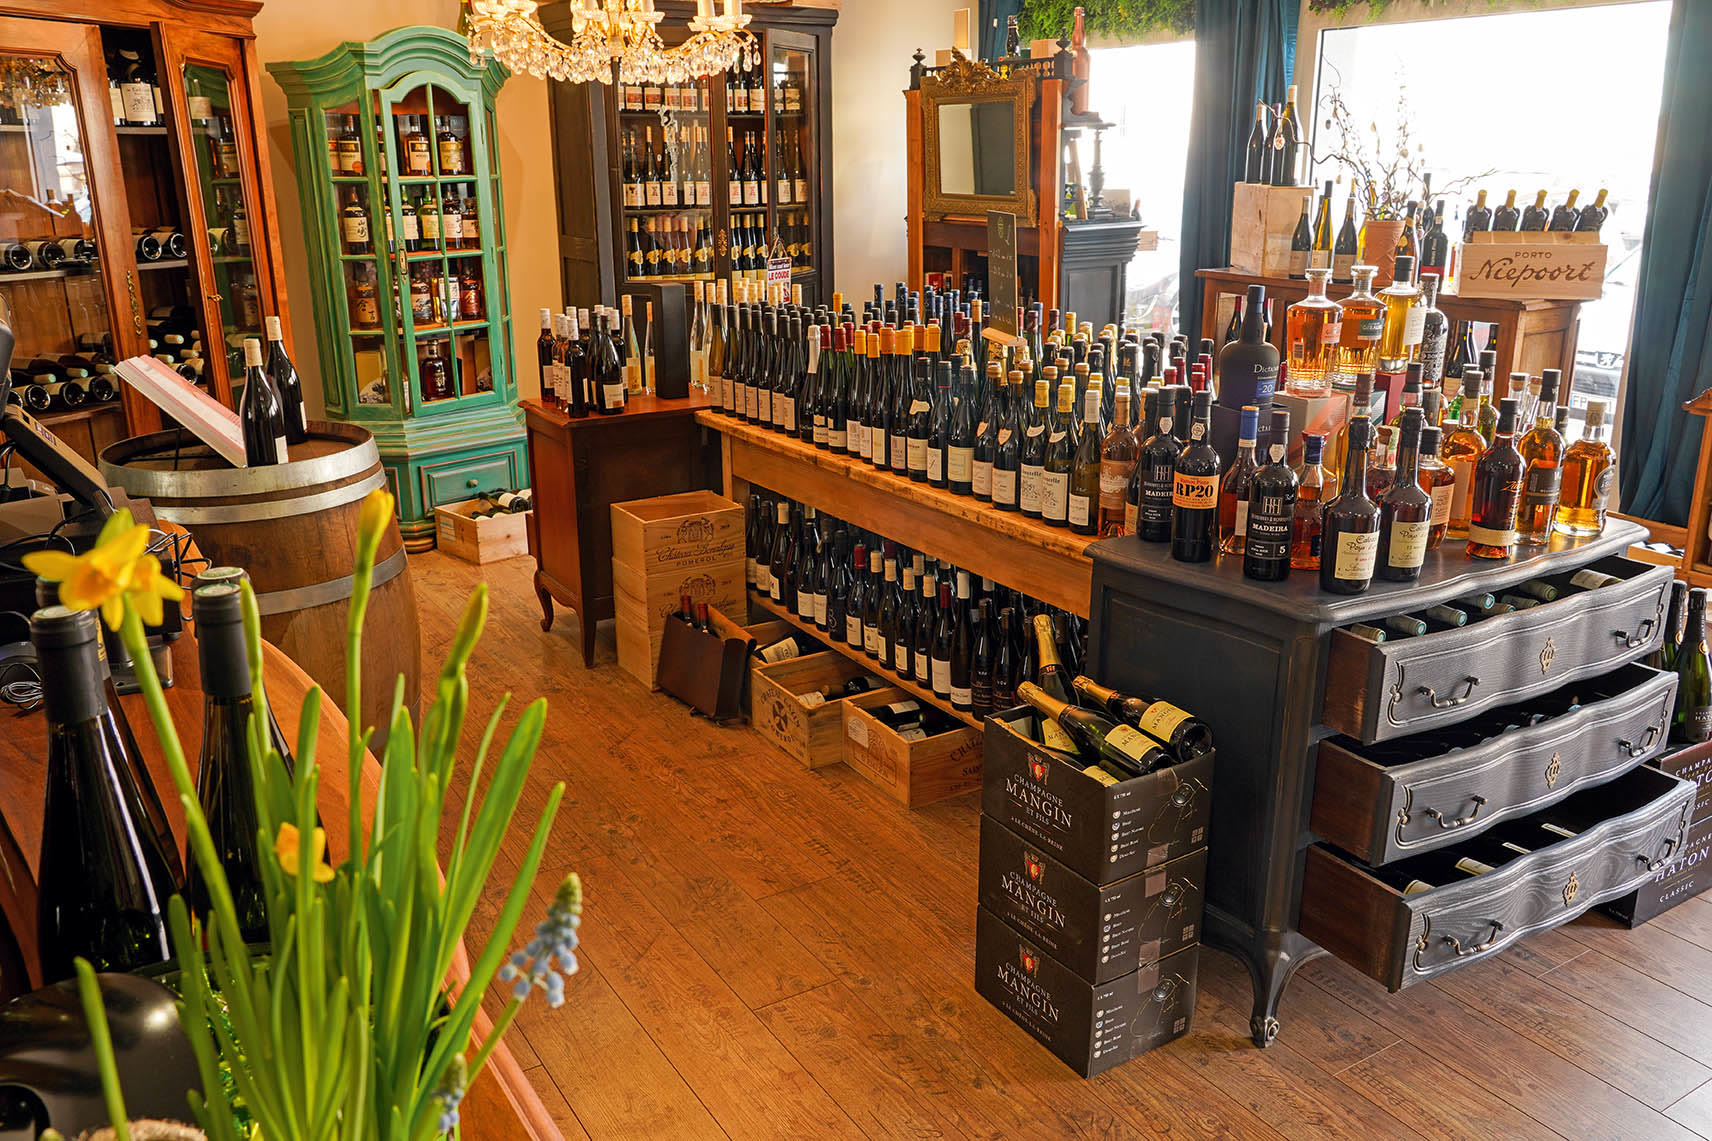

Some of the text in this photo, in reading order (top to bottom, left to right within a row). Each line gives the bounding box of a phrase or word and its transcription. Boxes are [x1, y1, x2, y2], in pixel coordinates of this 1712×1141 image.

[775, 270, 790, 280] COUDE
[1470, 257, 1596, 288] Niepoort
[1262, 383, 1273, 393] 20
[1175, 481, 1214, 498] RP20
[1252, 523, 1289, 532] MADEIRA
[1279, 545, 1286, 554] 5
[677, 557, 716, 567] POMEROL
[1014, 774, 1064, 807] CHAMPAGNE
[1006, 778, 1073, 828] MANGIN
[1026, 807, 1050, 825] ET FILS
[1001, 873, 1065, 928] MANGIN
[1010, 871, 1057, 908] CHAMPAGNE
[1659, 880, 1694, 903] CLASSIC
[1005, 962, 1051, 1001] CHAMPAGNE
[998, 965, 1059, 1022] MANGIN
